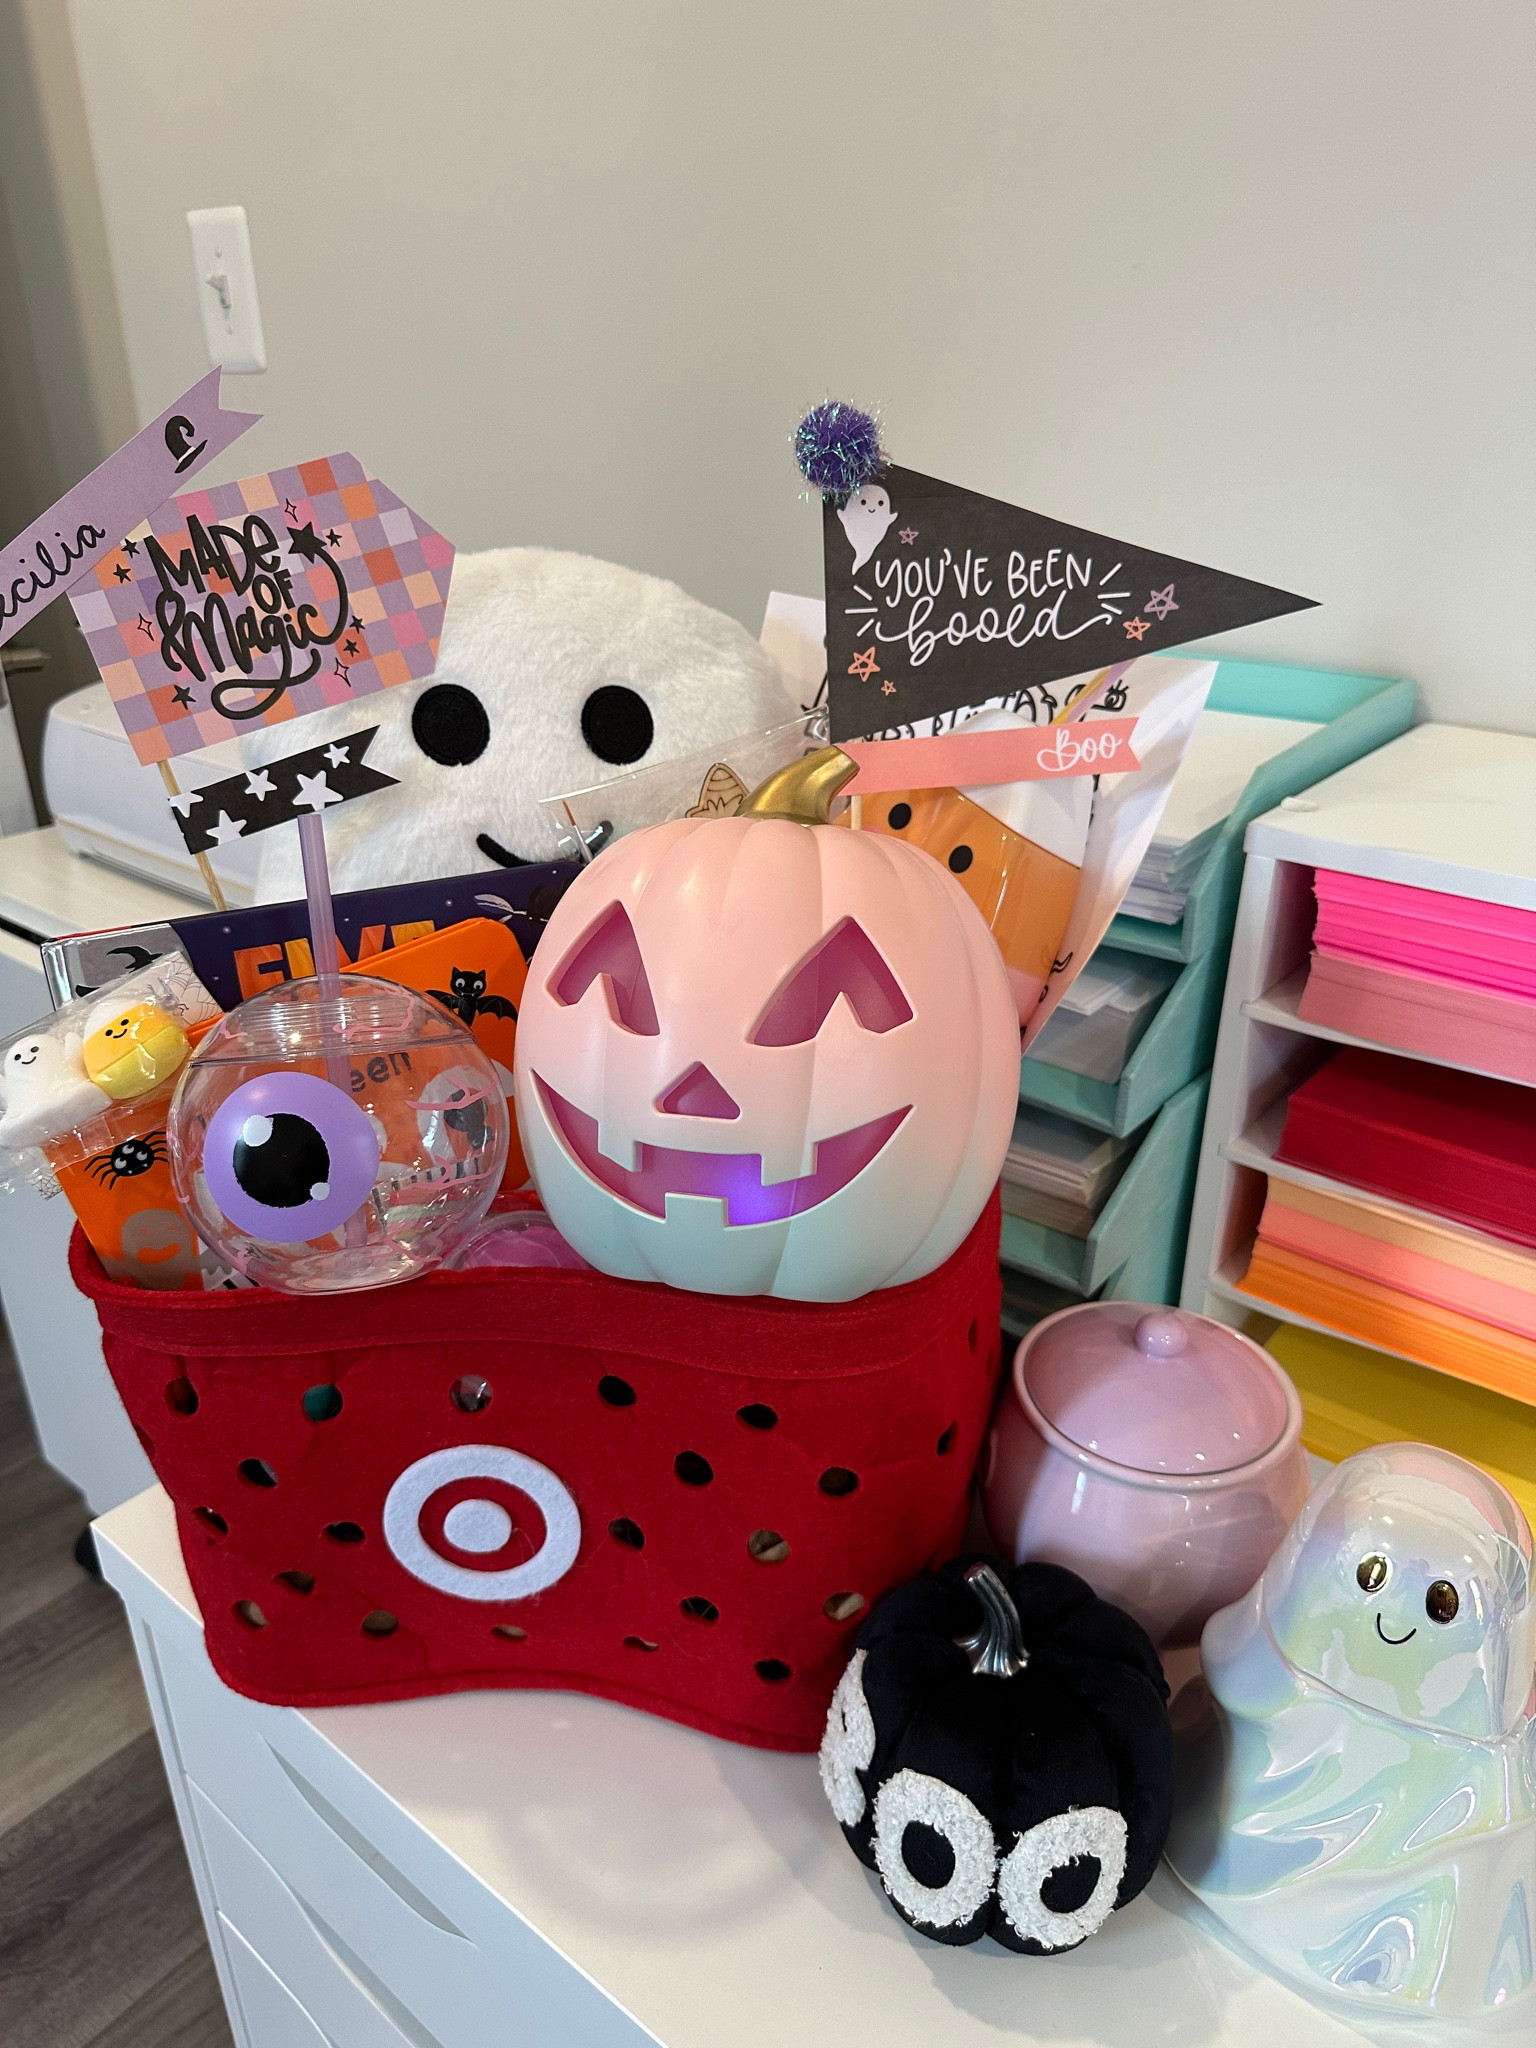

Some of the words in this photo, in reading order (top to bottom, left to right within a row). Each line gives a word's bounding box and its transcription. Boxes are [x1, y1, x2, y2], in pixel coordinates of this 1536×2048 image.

[252, 568, 296, 614] OF
[875, 548, 992, 608] YOU'VE
[1007, 549, 1092, 600] BEEN
[1036, 728, 1124, 772] Boo
